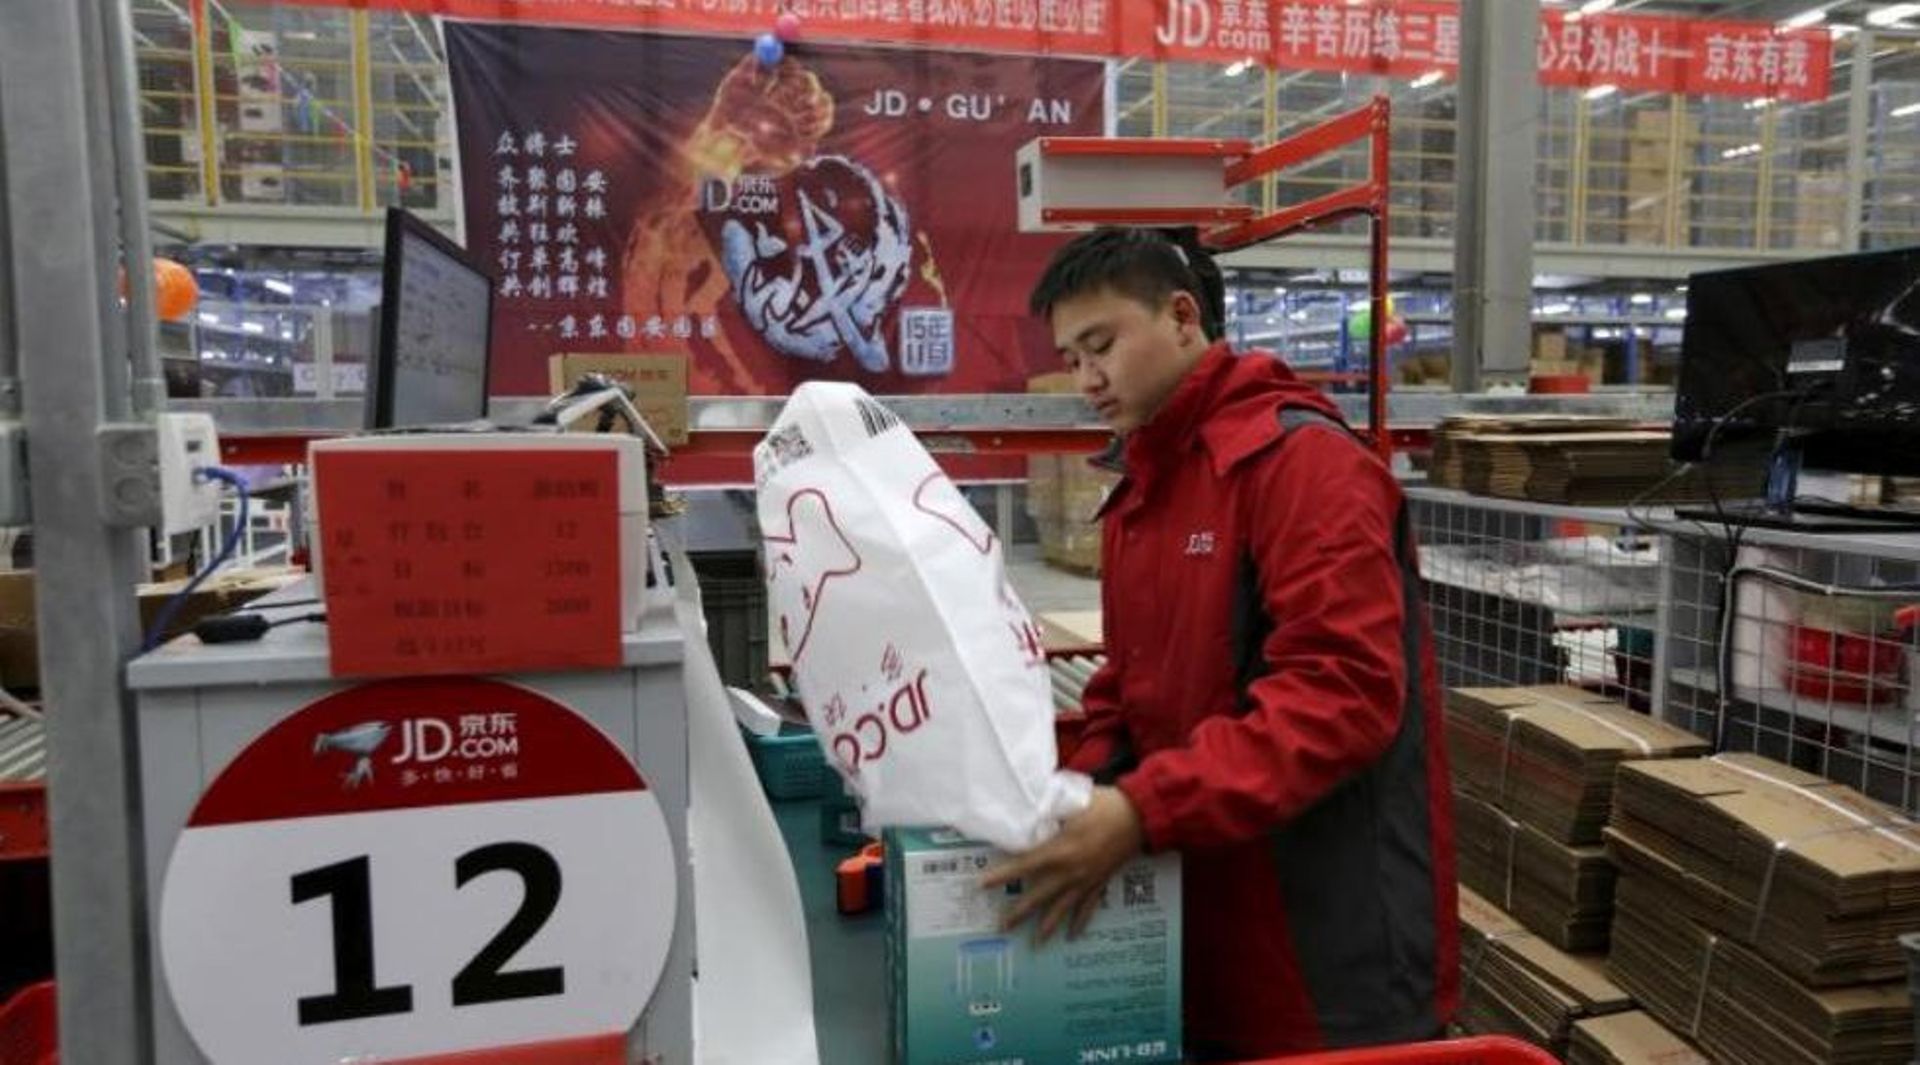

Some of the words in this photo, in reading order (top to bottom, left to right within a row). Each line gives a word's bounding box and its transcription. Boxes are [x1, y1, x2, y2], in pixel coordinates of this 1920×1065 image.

[1704, 33, 1809, 87] 京东有我
[864, 91, 906, 117] JD
[1028, 99, 1072, 124] AN
[392, 718, 519, 764] JD.COM
[459, 712, 518, 738] 京东
[290, 841, 566, 1027] 12
